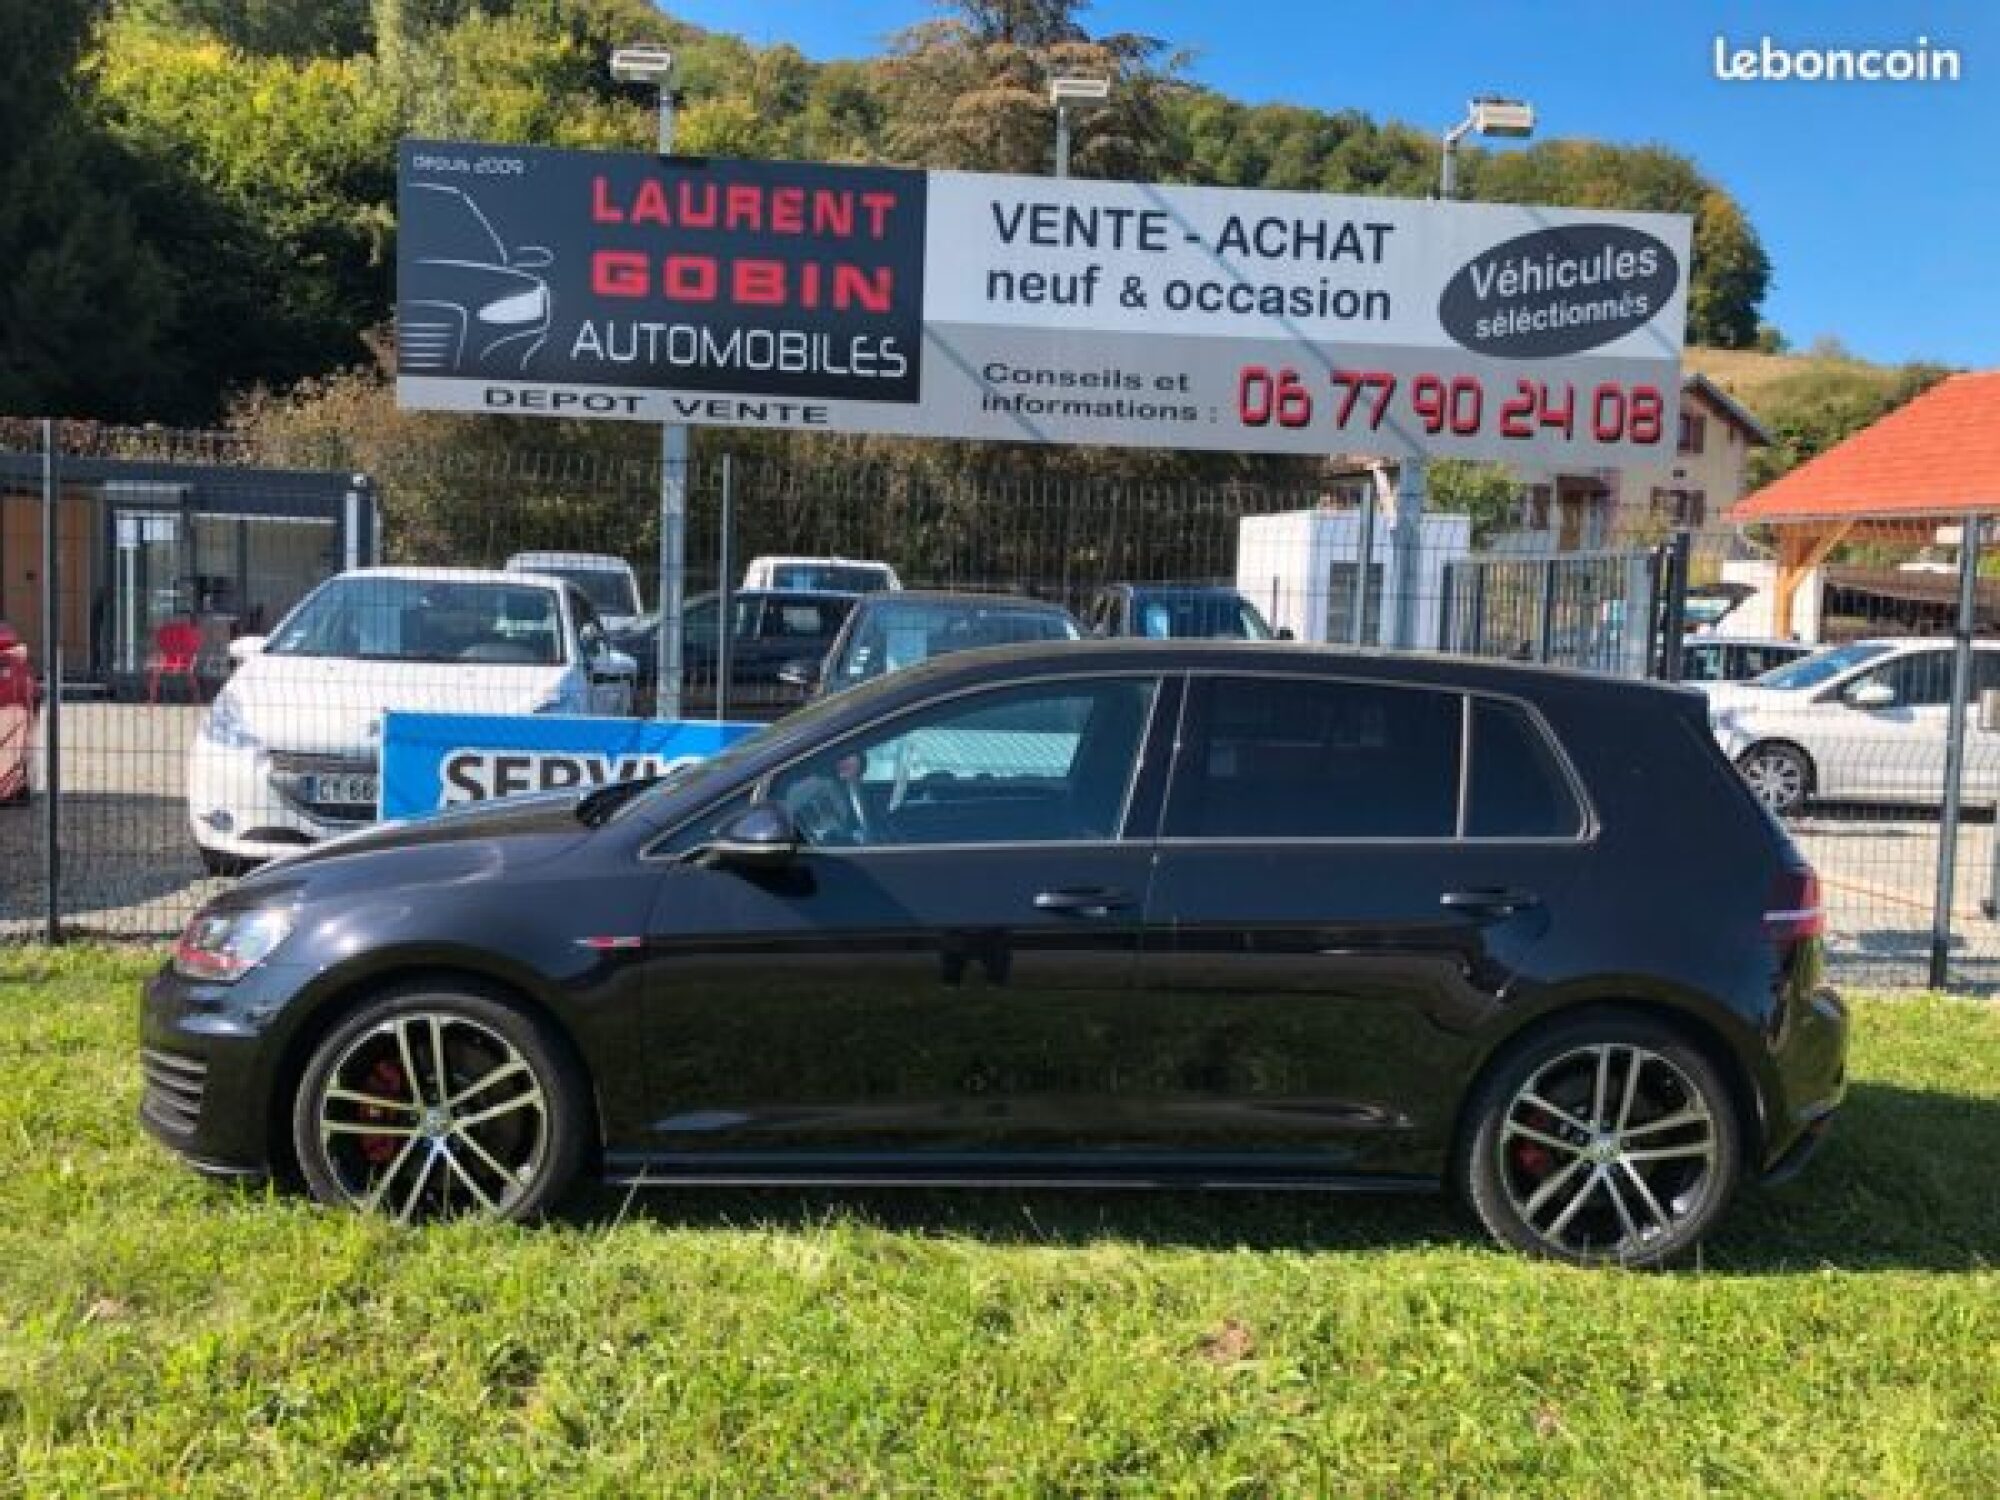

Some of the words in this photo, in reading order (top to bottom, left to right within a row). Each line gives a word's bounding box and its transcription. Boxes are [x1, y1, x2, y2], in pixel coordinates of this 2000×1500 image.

[591, 176, 896, 240] LAURENT
[992, 200, 1170, 252] VENTE
[1216, 214, 1397, 265] ACHAT
[590, 249, 893, 313] GOBIN
[987, 263, 1102, 307] neuf
[1119, 274, 1148, 311] &
[1163, 277, 1391, 321] occasion
[1469, 244, 1658, 300] Véhicules
[570, 320, 906, 378] AUTOMOBILES
[983, 362, 1143, 392] Conseils
[1154, 371, 1190, 394] et
[484, 386, 645, 415] DEPOT
[672, 398, 828, 425] VENTE
[1239, 366, 1313, 428] 06
[1330, 369, 1397, 432] 77
[1410, 372, 1484, 438] 90
[1501, 378, 1576, 442] 24
[1592, 381, 1665, 445] 08
